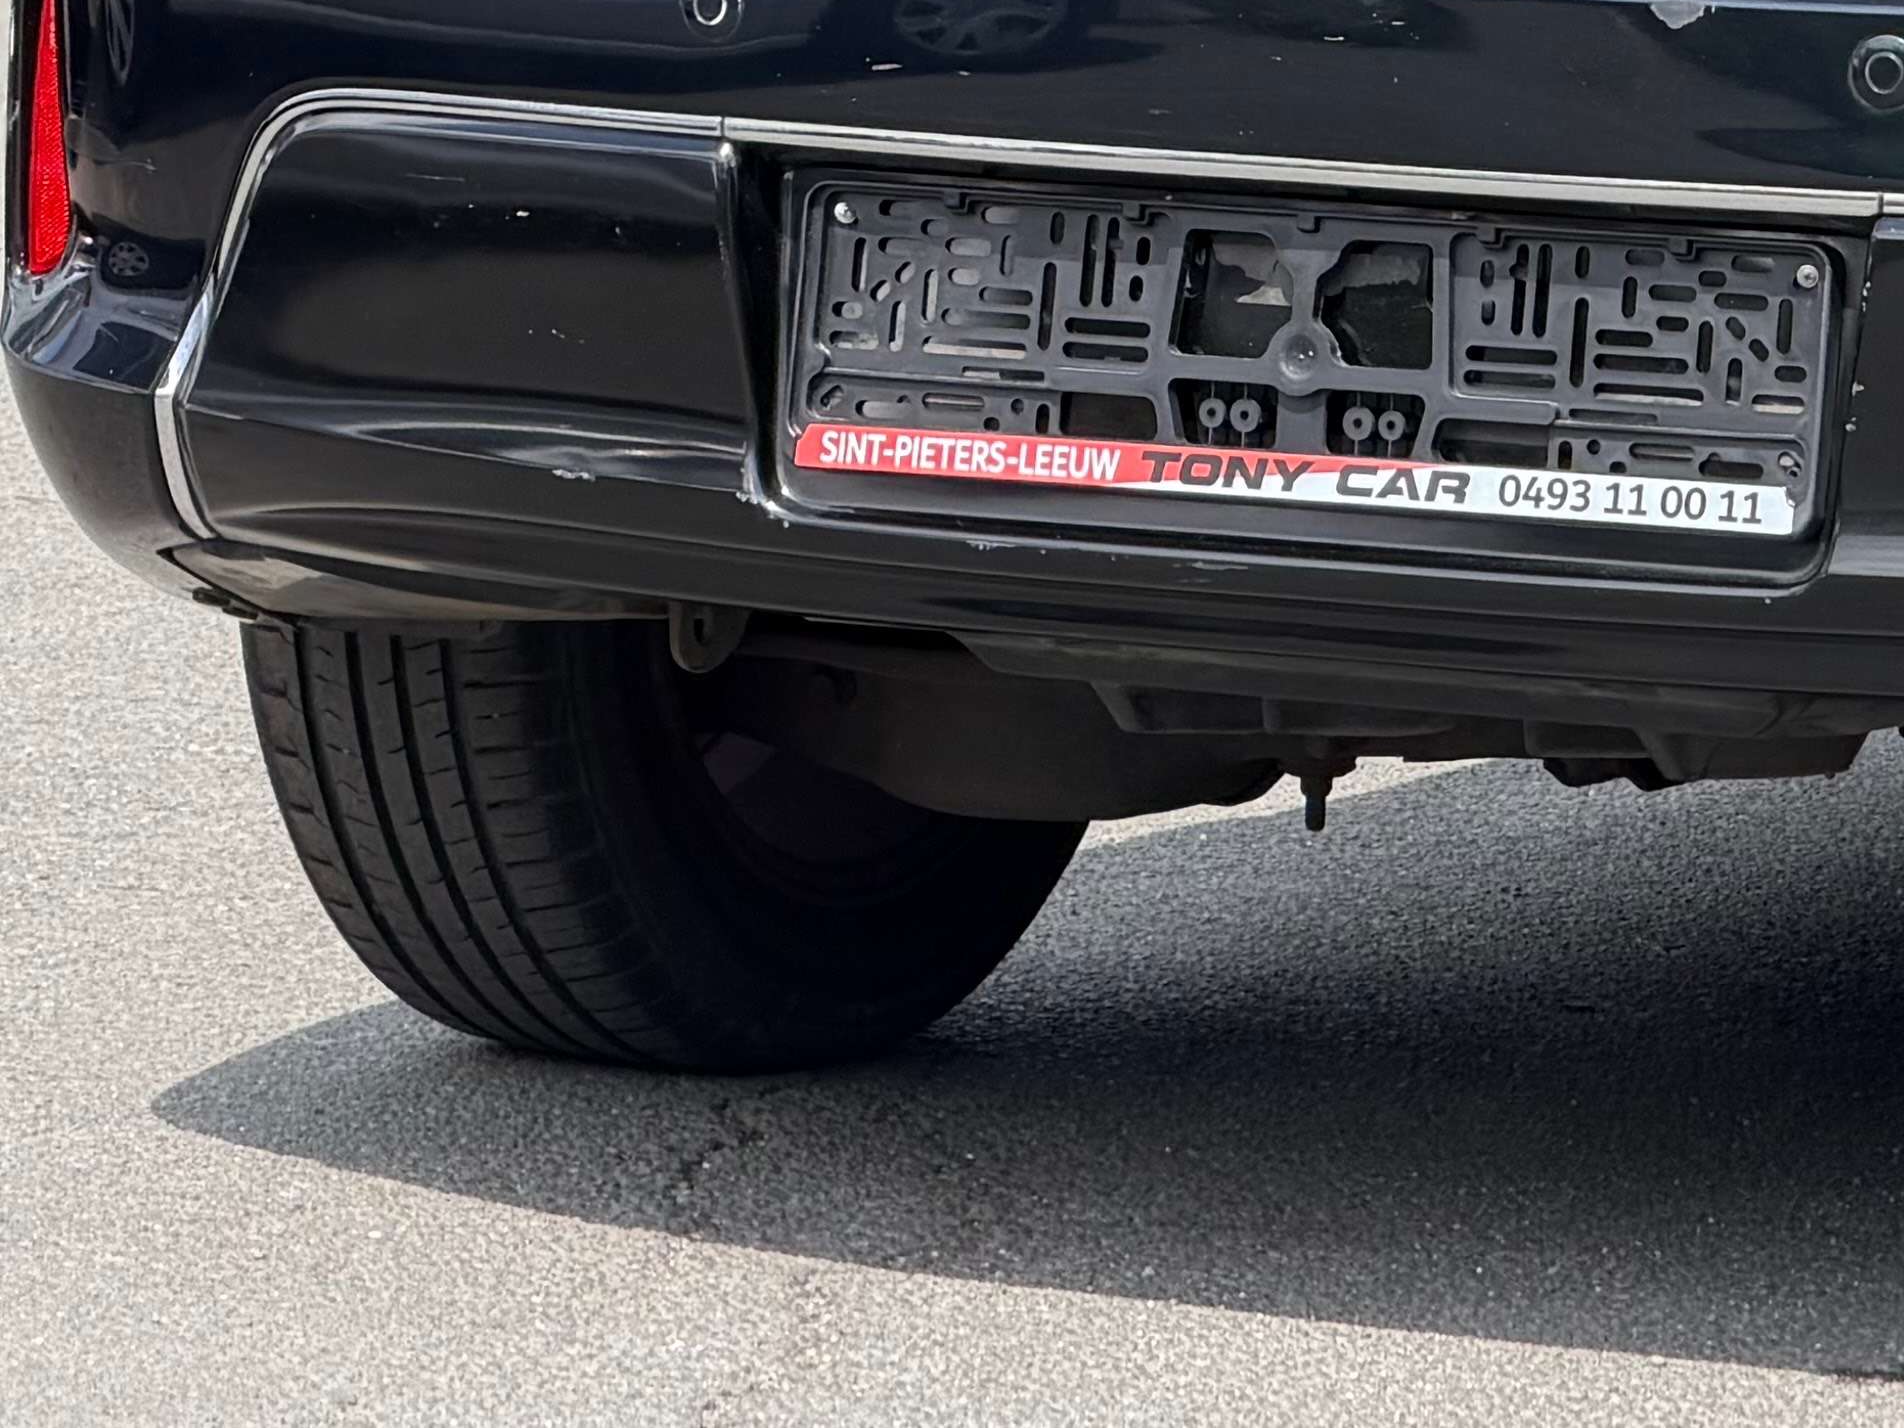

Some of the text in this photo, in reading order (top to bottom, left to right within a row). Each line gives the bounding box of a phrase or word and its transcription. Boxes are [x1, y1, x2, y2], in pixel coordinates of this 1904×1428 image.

[820, 430, 1763, 525] SINT-PIETERS-LEEUW TONY CAR 0493 11 00 11
